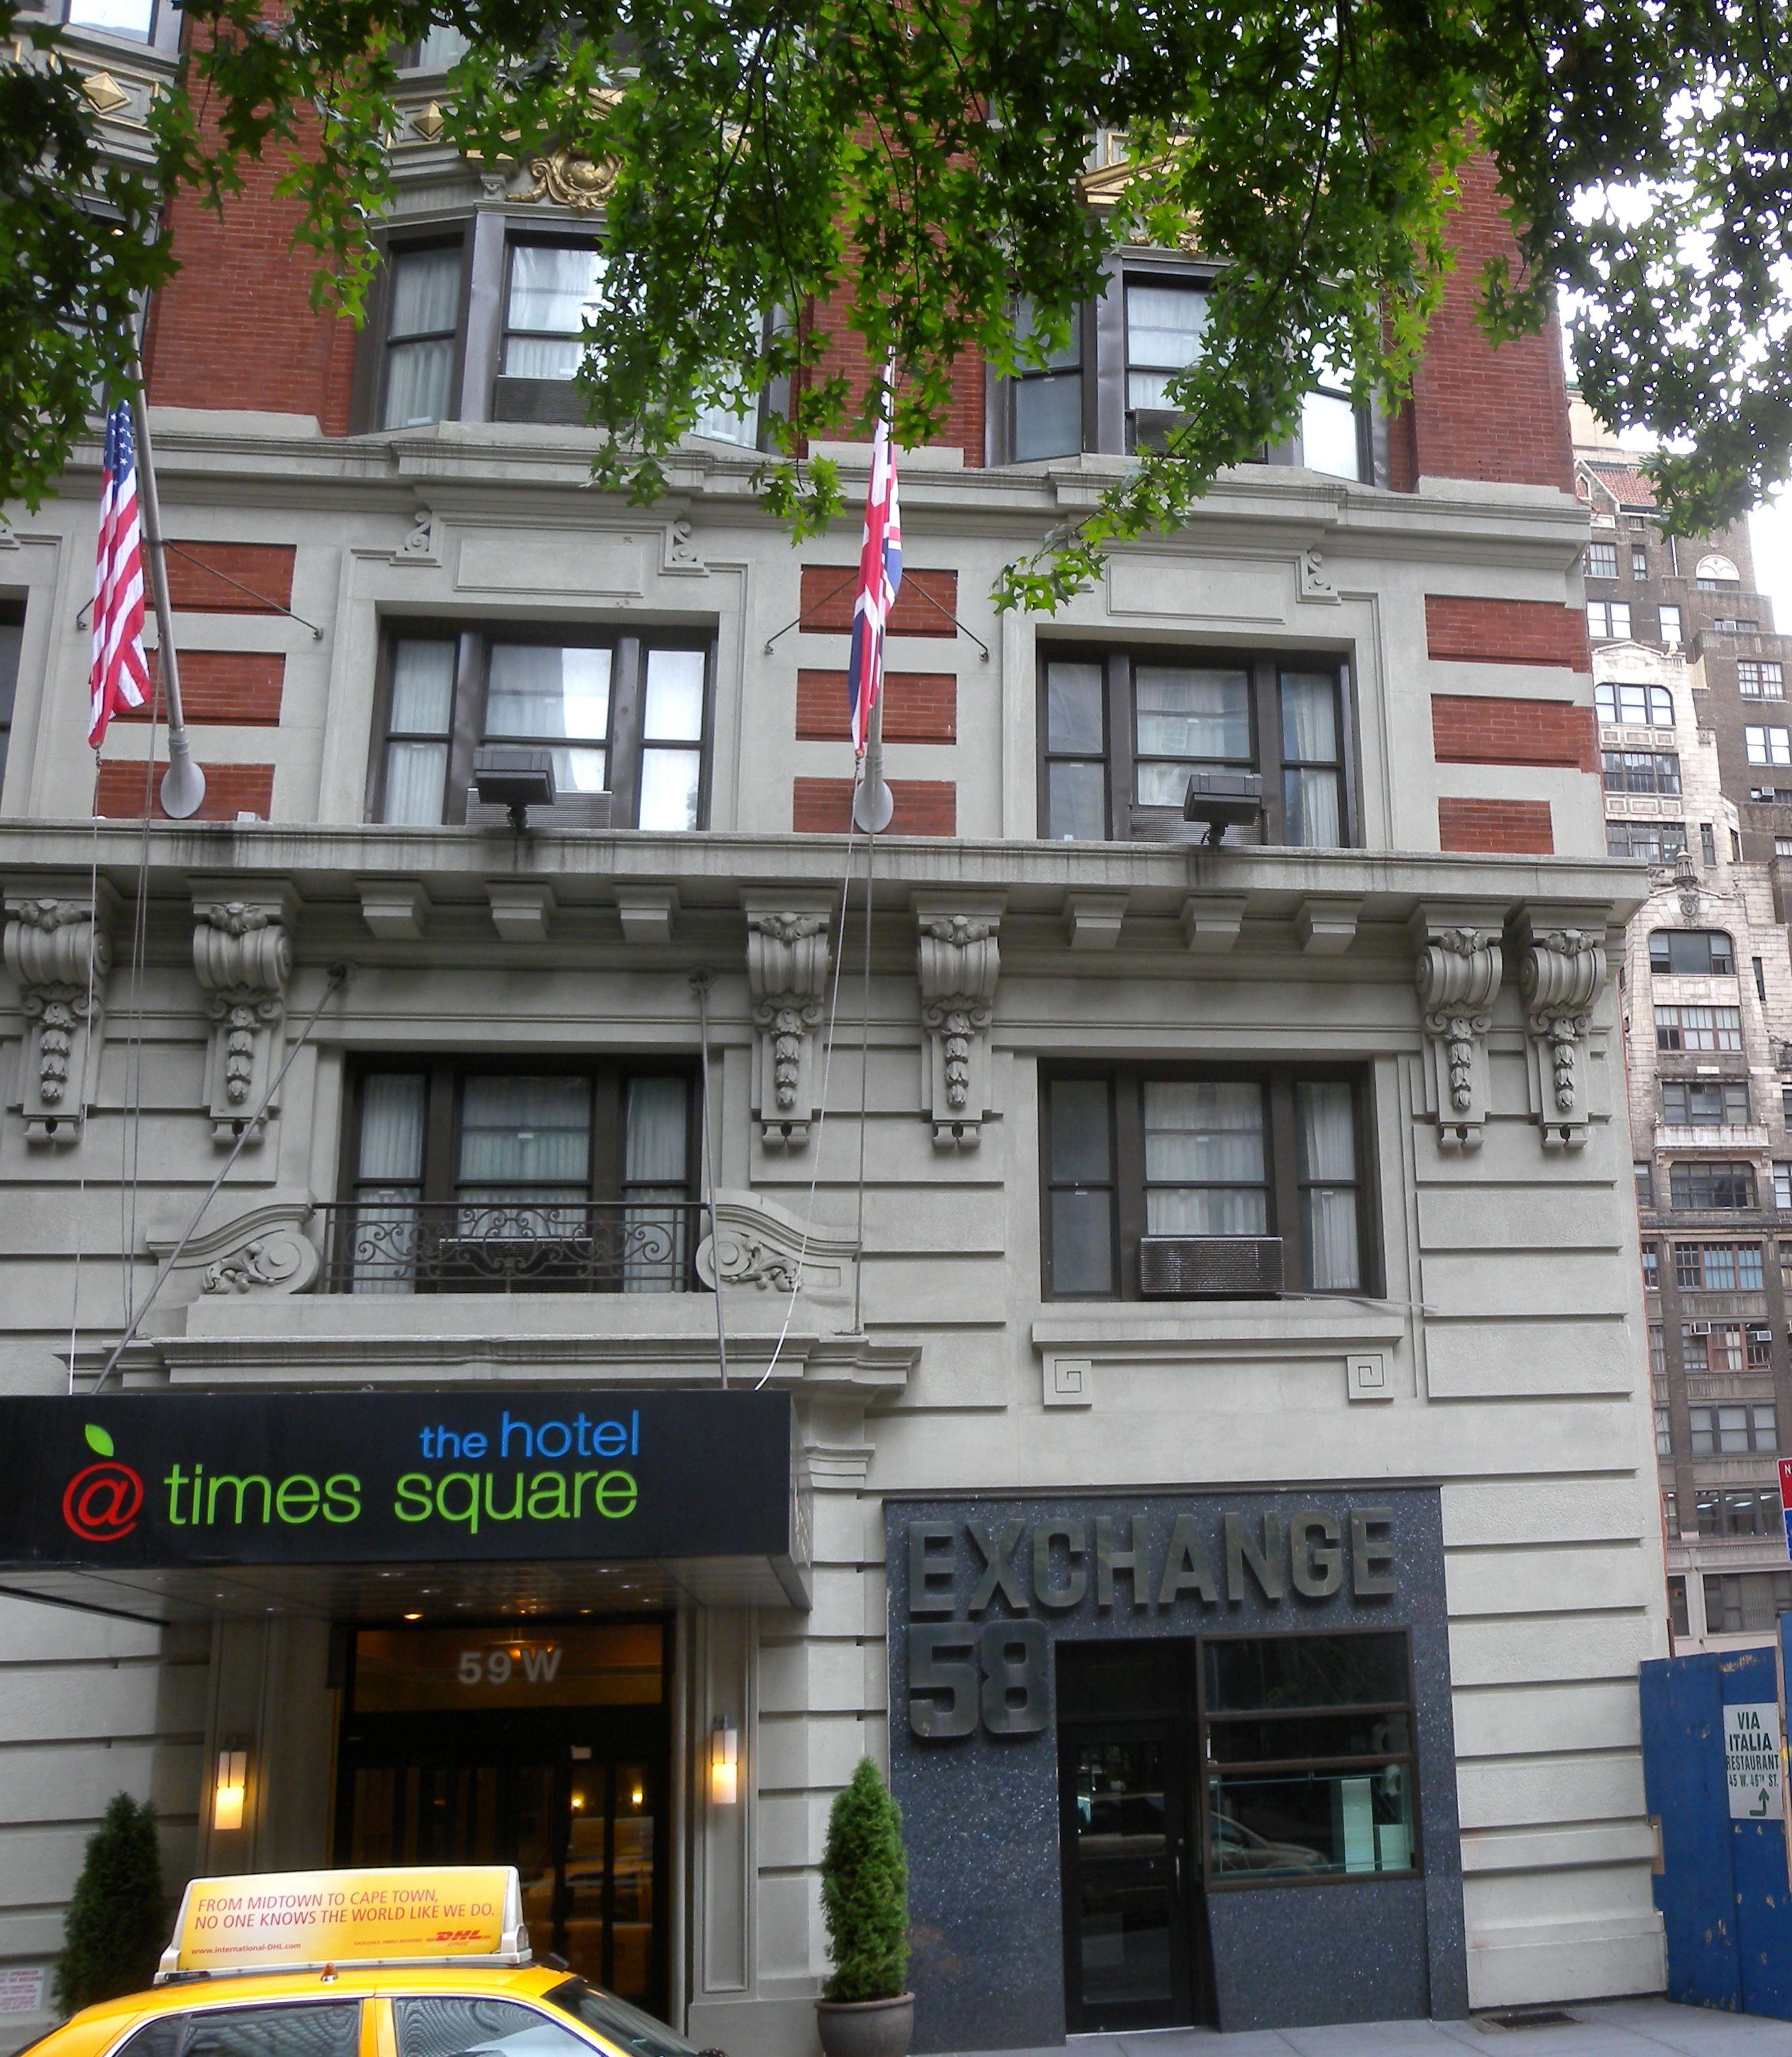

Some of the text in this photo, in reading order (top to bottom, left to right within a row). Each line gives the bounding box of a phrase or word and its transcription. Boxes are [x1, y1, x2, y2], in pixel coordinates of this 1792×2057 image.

[420, 1410, 640, 1458] the hotel
[163, 1463, 362, 1525] times
[394, 1471, 638, 1535] square
[908, 1506, 1397, 1612] EXCHANGE
[457, 1648, 564, 1685] 59 W
[908, 1619, 1051, 1739] 58
[1737, 1712, 1760, 1730] VIA
[1729, 1732, 1772, 1752] ITALIA
[1727, 1754, 1779, 1771] RESTAURANT
[1729, 1774, 1737, 1787] 45
[1739, 1774, 1748, 1787] W.
[1768, 1774, 1779, 1787] ST.
[197, 1889, 438, 1912] FROM MIDTOWN TO CAPE TOWN,
[194, 1902, 495, 1930] NO ONE KNOWS THE WORLD LIKE WE DO.
[435, 1929, 484, 1942] DHL
[191, 1942, 301, 1955] www.international-DHL.com
